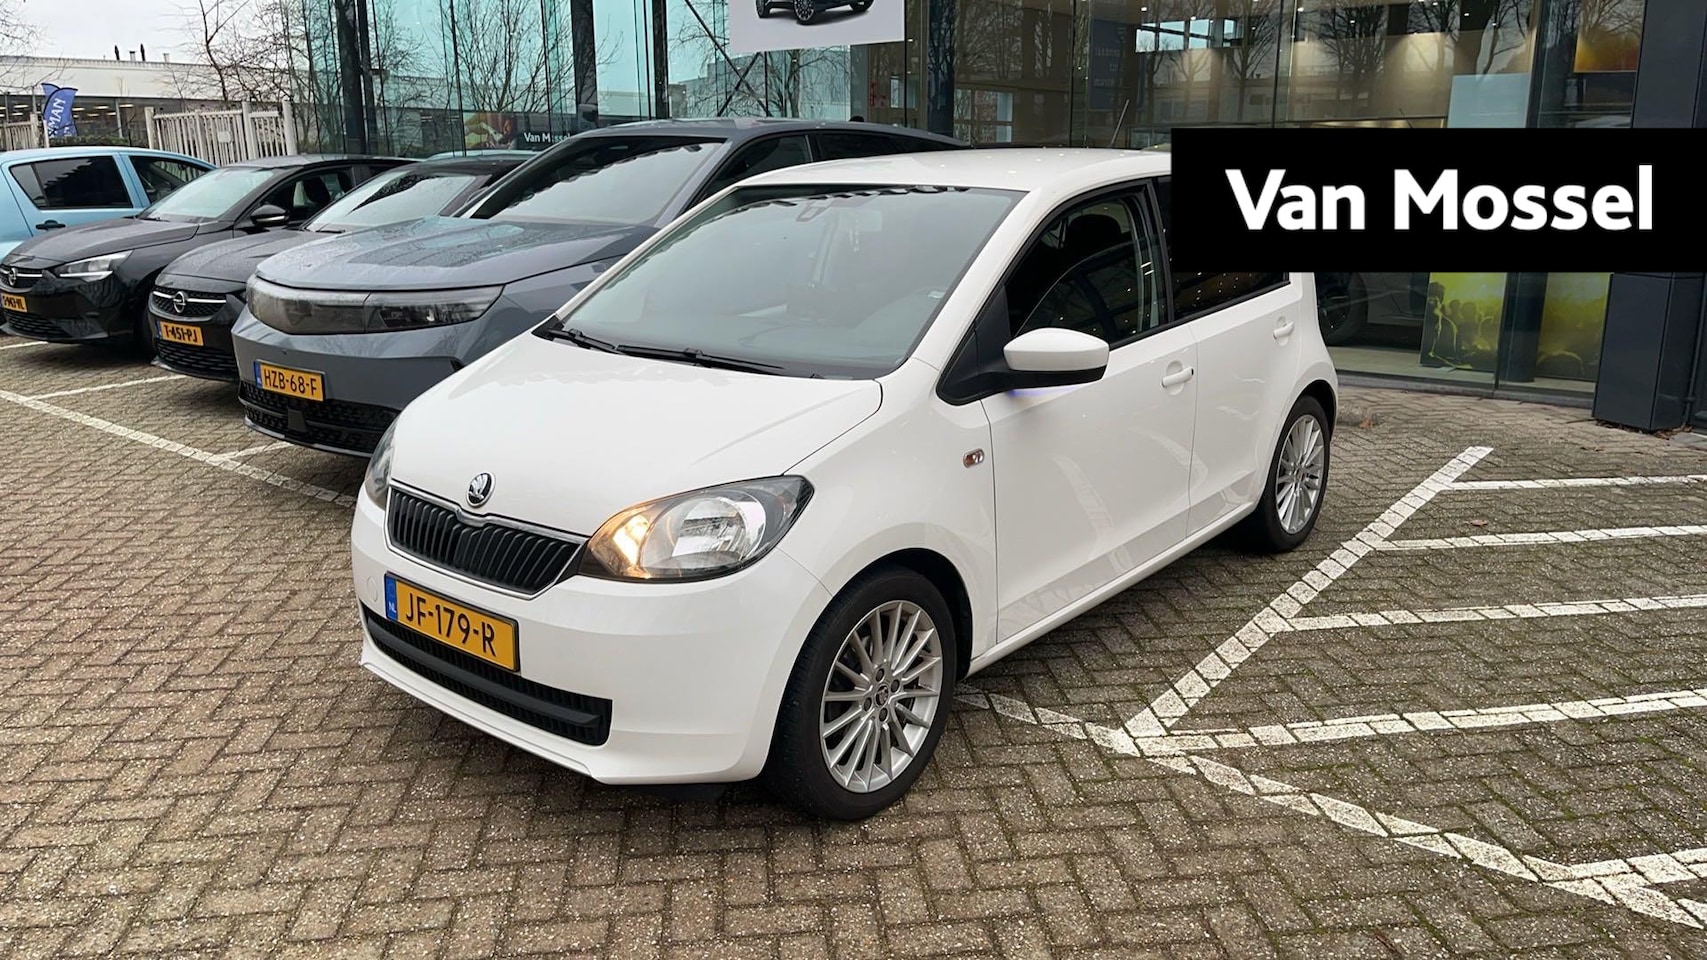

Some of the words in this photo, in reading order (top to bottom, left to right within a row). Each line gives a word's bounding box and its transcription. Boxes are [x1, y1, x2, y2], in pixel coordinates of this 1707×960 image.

[523, 132, 541, 142] Van
[542, 133, 571, 143] Msse
[163, 324, 198, 343] T-451-PJ
[263, 368, 318, 396] HZB-68-F
[388, 601, 397, 613] NL
[405, 592, 497, 658] JF-179-R
